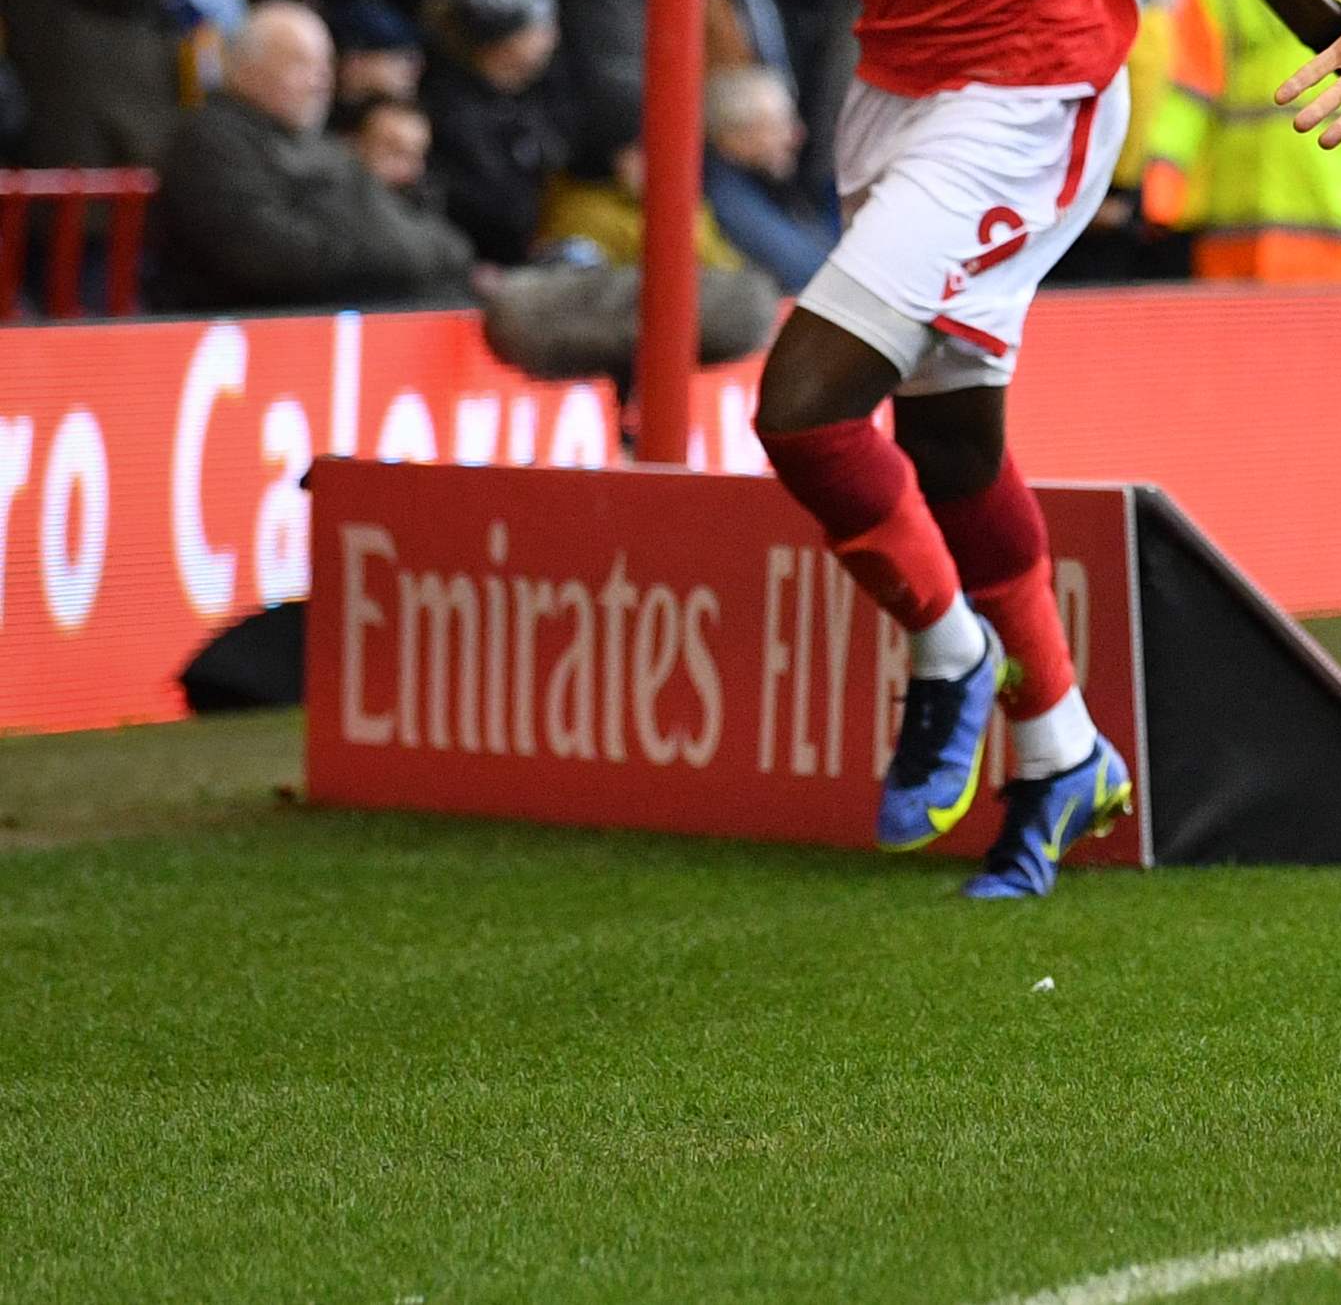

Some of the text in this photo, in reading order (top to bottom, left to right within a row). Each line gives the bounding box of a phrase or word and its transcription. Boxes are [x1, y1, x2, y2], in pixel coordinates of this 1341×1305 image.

[961, 205, 1030, 279] 9
[339, 520, 723, 769] Emirates
[756, 545, 856, 779] FLY
